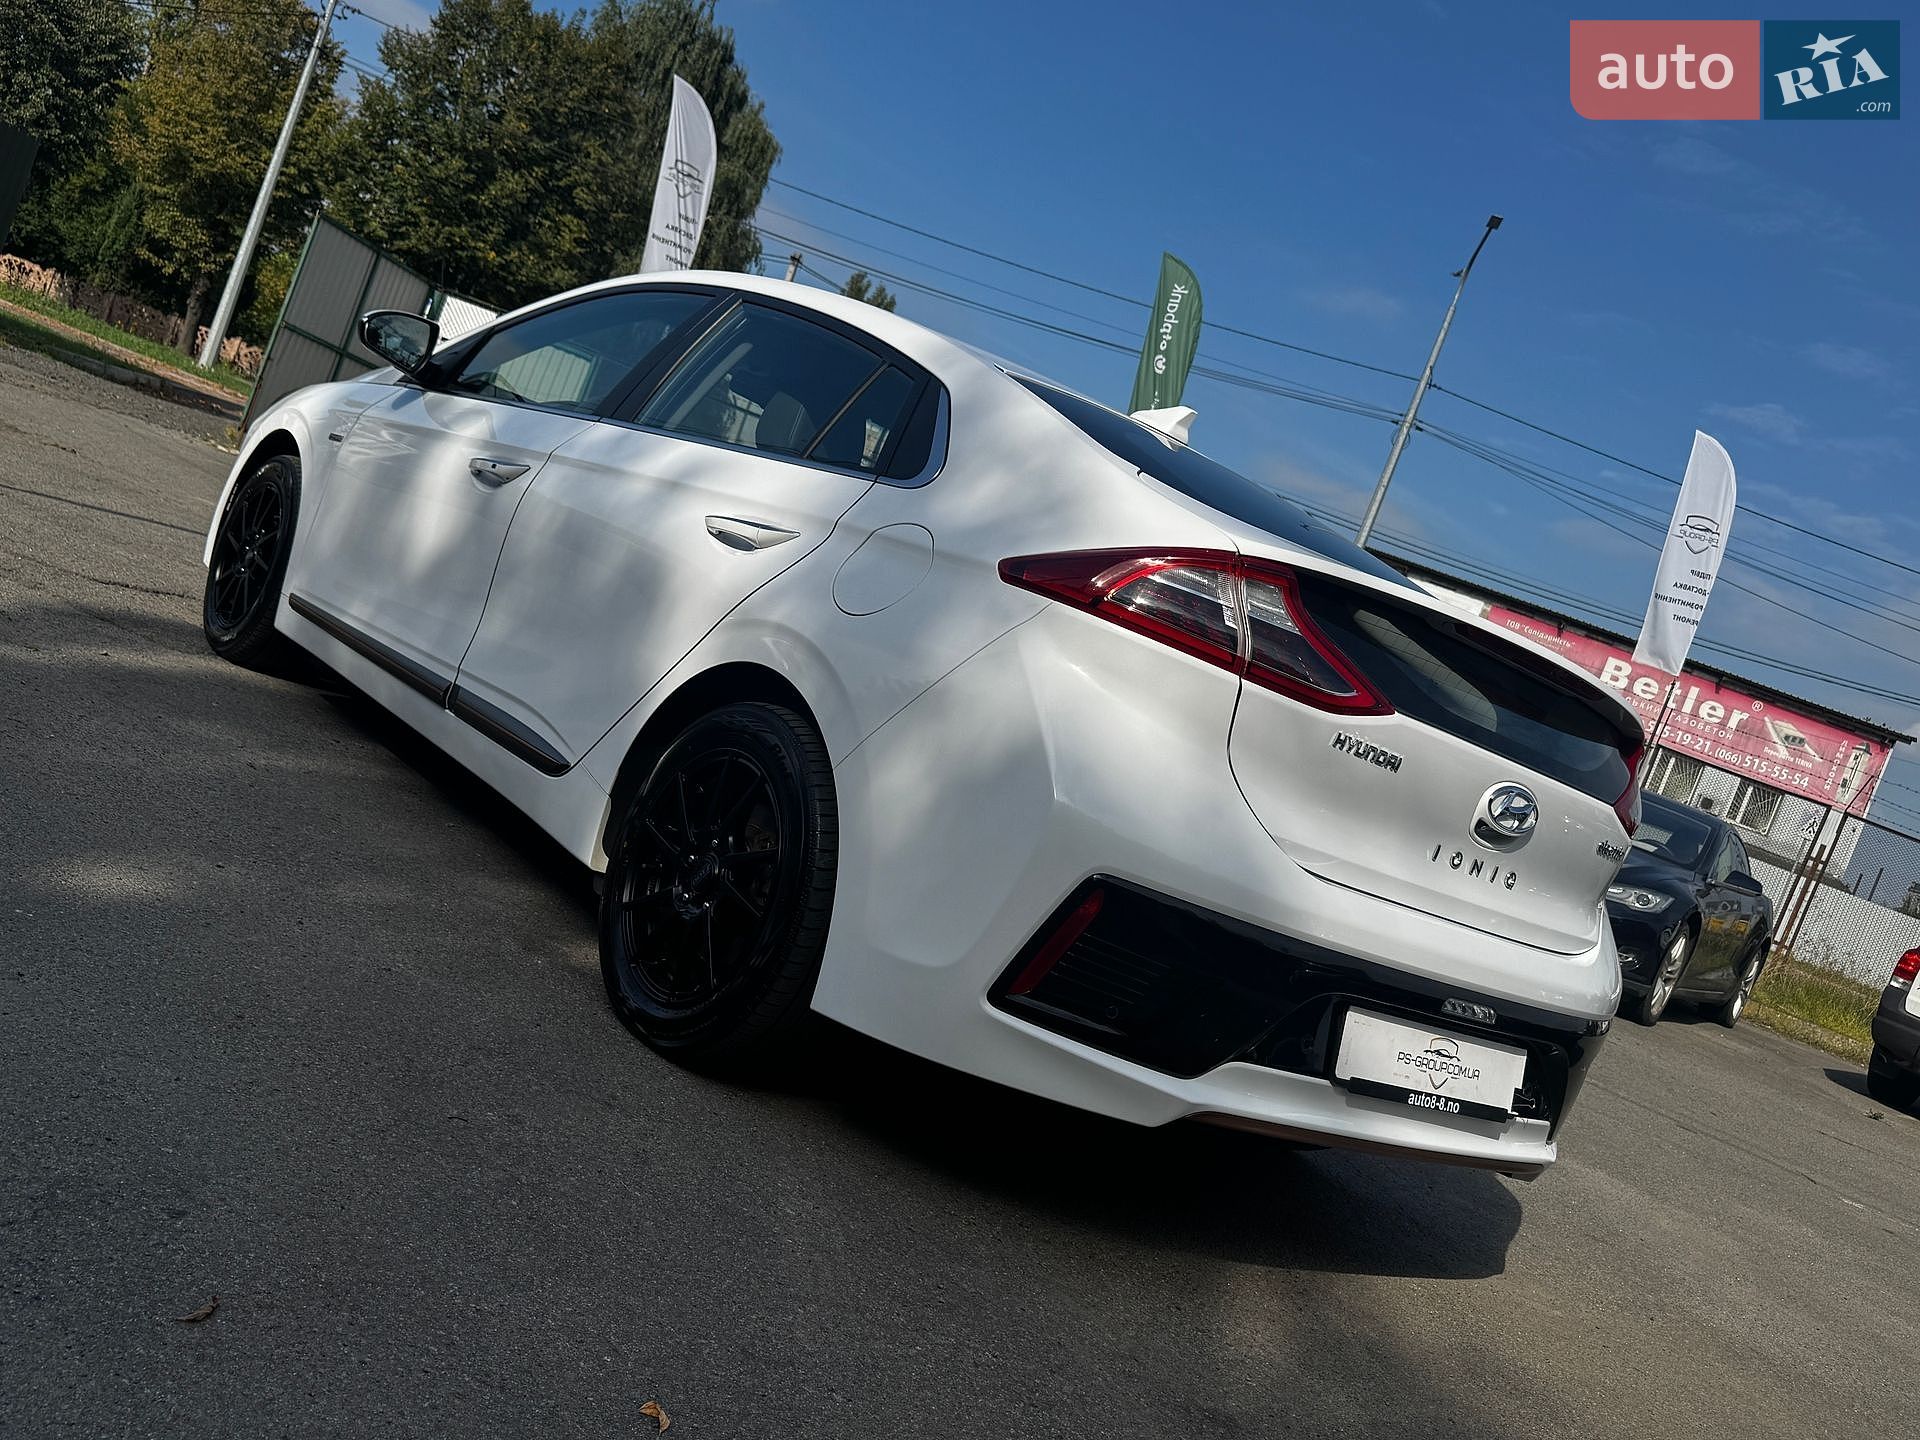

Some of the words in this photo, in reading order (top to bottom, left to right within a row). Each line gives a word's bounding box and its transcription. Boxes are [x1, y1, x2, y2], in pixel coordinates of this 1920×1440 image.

[1600, 656, 1750, 731] Betler
[1332, 732, 1403, 774] HYUNDAI
[1715, 747, 1742, 765] (066)
[1743, 757, 1809, 788] 515-55-54
[1431, 845, 1517, 890] IONIQ
